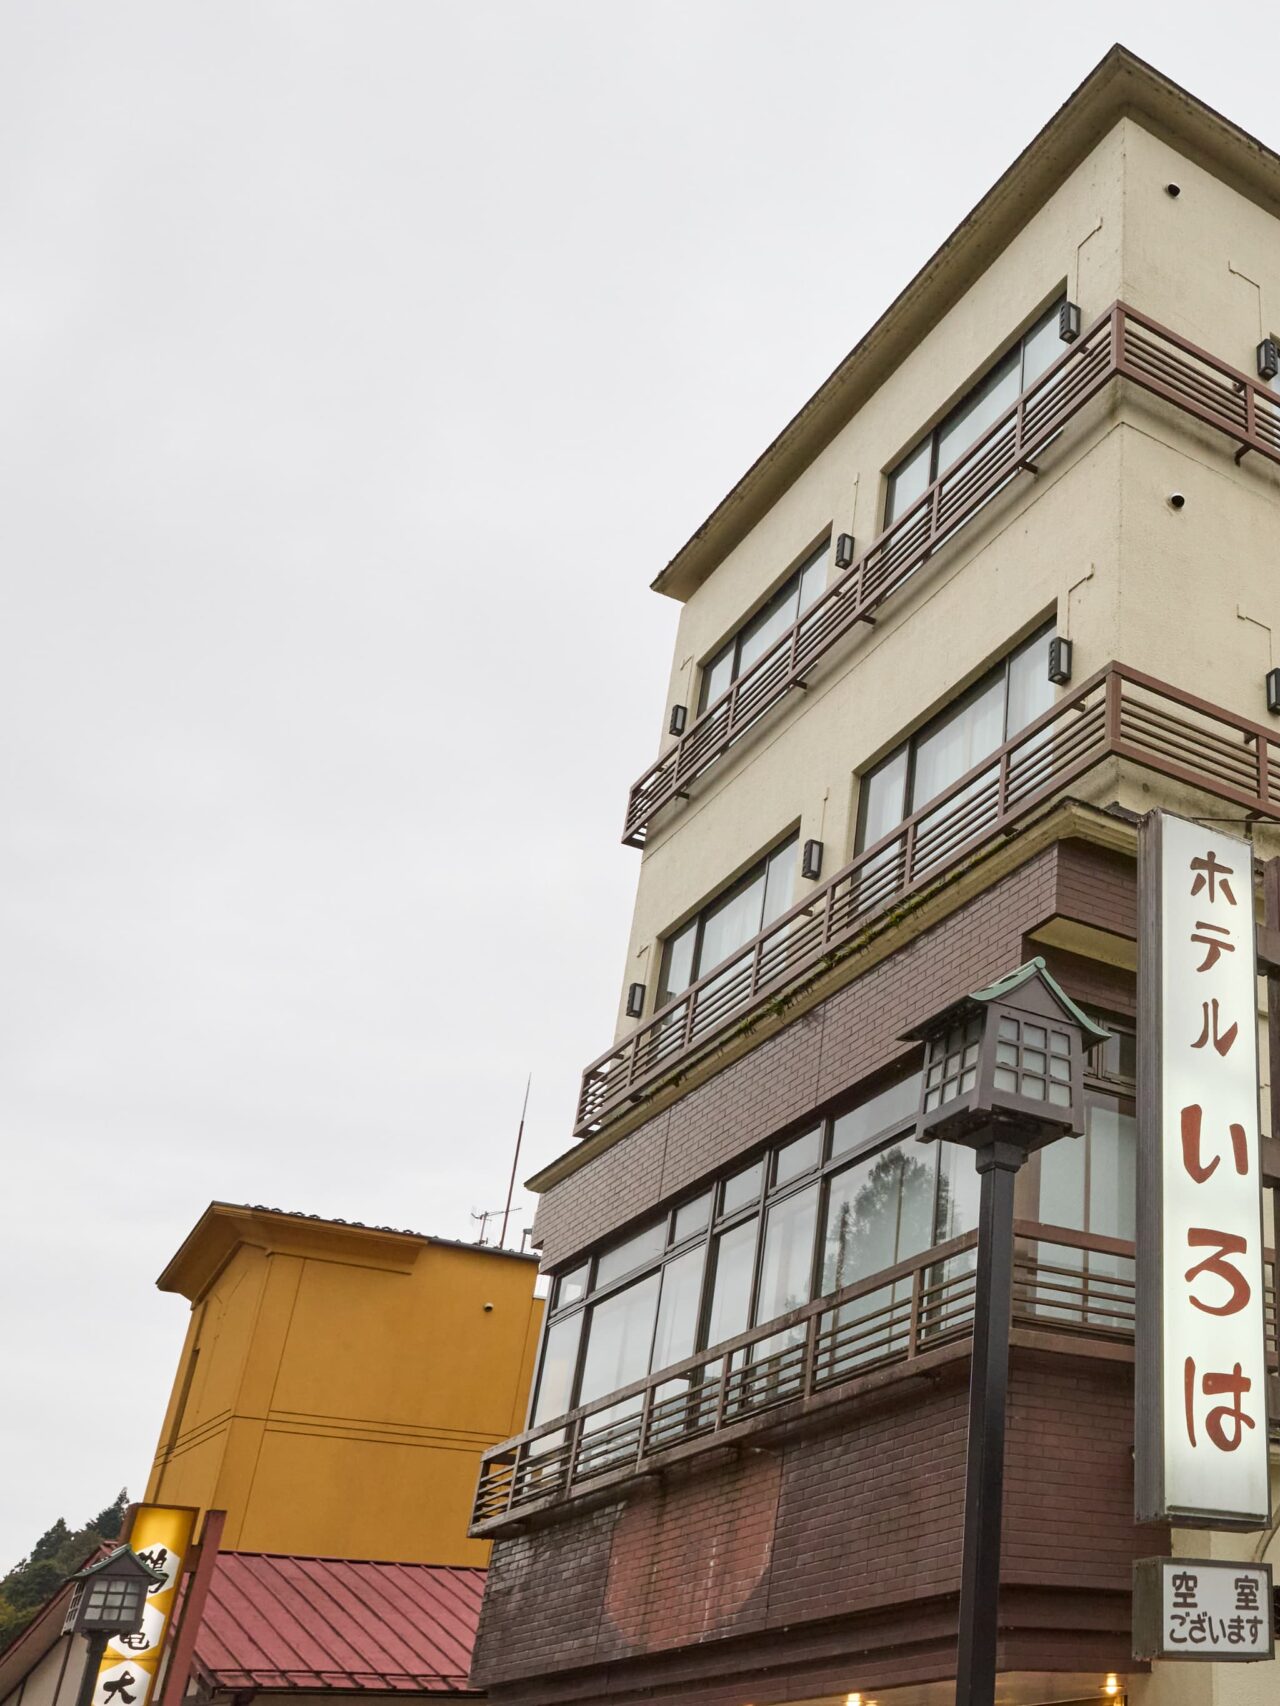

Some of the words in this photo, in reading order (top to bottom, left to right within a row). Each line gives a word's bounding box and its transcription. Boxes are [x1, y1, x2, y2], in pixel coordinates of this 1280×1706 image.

[1181, 851, 1255, 1452] ホテルいろは
[1169, 1611, 1263, 1645] ございます
